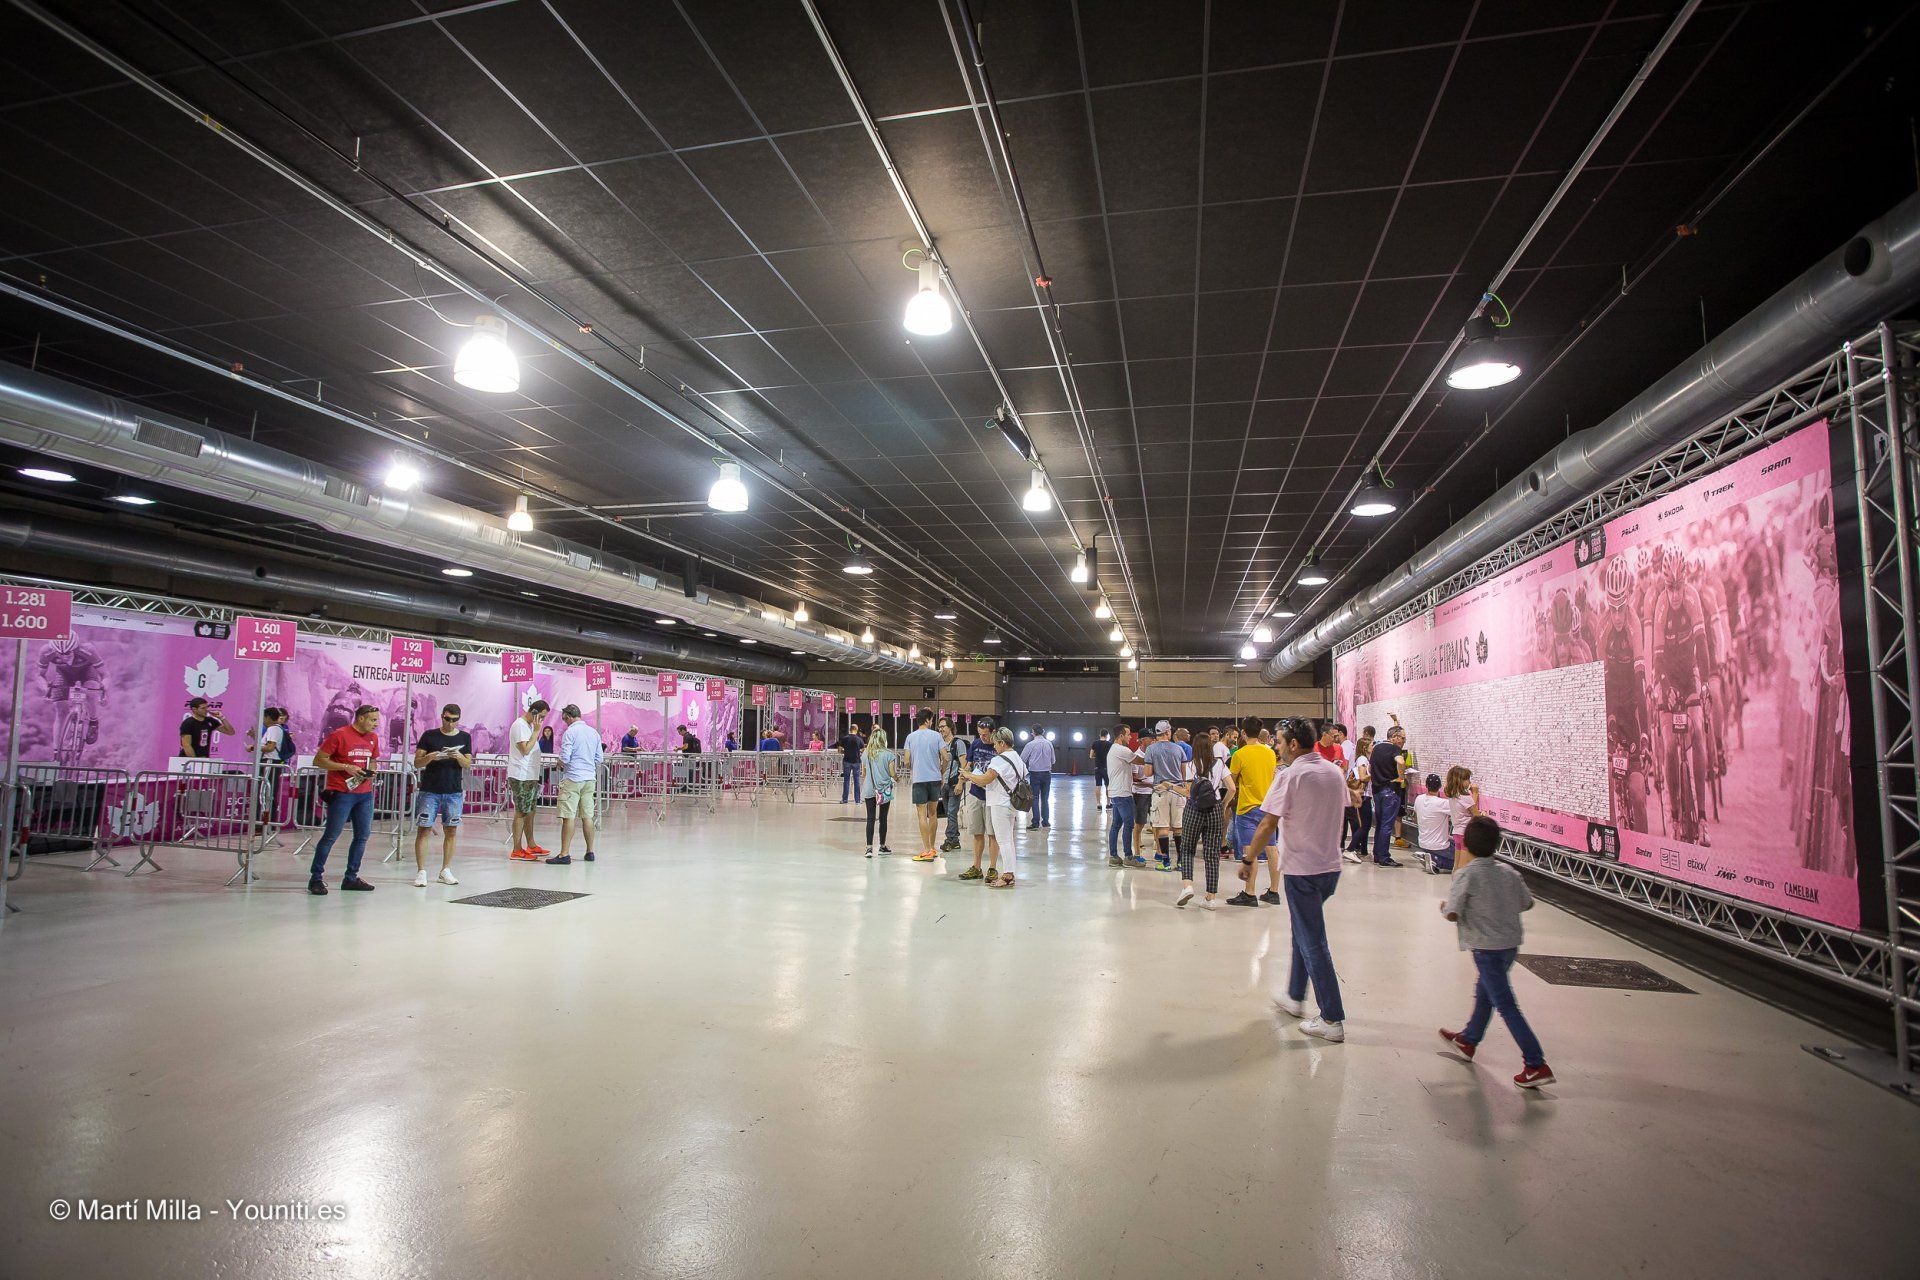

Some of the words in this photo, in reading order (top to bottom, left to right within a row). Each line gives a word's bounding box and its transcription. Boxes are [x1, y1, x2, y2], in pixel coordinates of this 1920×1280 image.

[1711, 482, 1735, 497] TREK
[1761, 456, 1792, 475] SRAM
[6, 591, 46, 606] 1.281
[2, 614, 47, 629] 1.600
[255, 622, 280, 635] 1.601
[252, 641, 280, 653] 1.920
[403, 642, 422, 652] 1.921
[401, 656, 423, 667] 2.240
[510, 655, 525, 663] 2.241
[1440, 636, 1470, 674] FIRMAS
[353, 665, 393, 681] ENTREGA
[412, 672, 450, 685] ORSALES
[509, 668, 526, 676] 2.560
[1754, 878, 1775, 889] GIRO
[1784, 882, 1819, 904] CAMELBAK
